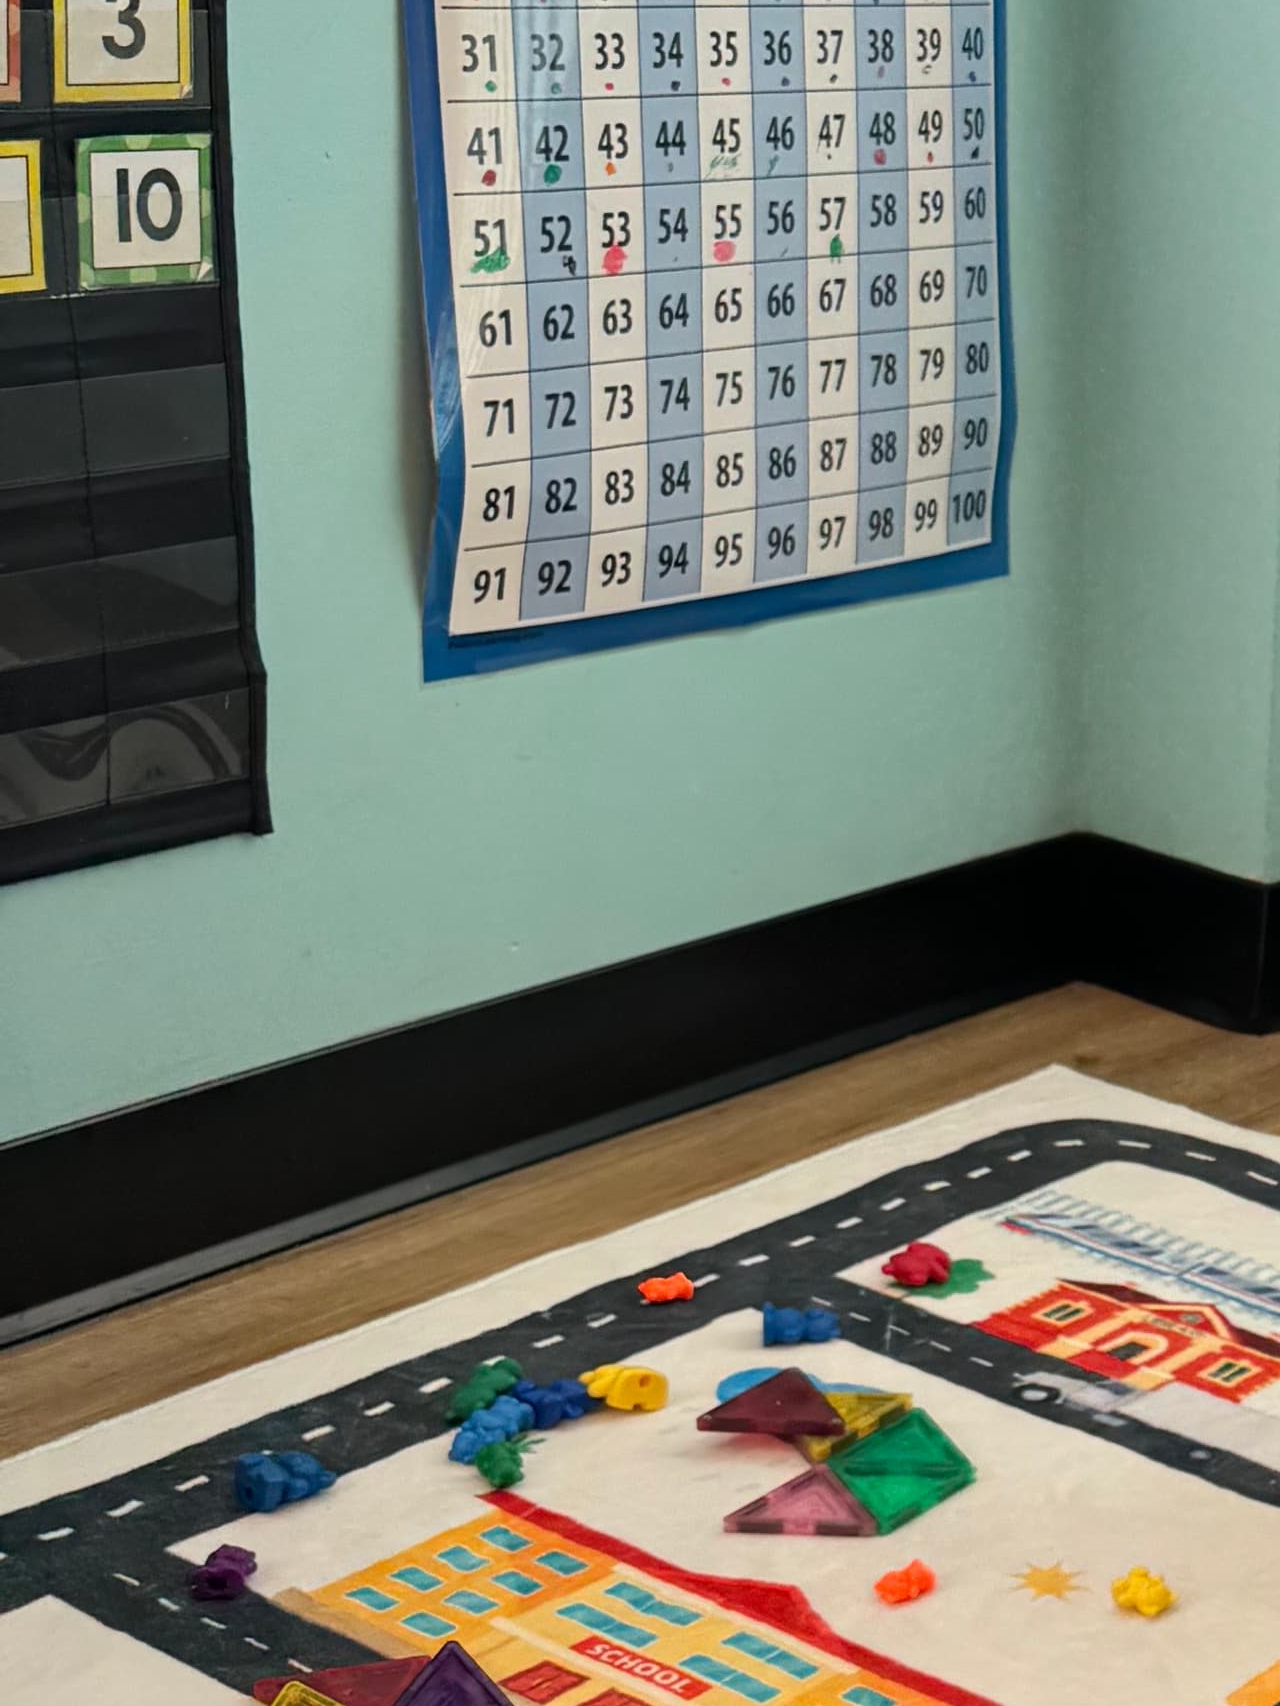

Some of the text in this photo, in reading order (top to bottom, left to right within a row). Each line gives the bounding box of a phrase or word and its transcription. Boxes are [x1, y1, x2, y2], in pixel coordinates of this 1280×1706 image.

[461, 26, 984, 73] 31 32 33 34 35 36 37 38 39 40
[466, 107, 985, 166] 41 42 43 44 45 46 47 48 49 50
[116, 167, 183, 243] 10
[474, 186, 986, 257] 51 52 53 54 55 56 57 58 59 60
[479, 264, 988, 348] 61 62 63 64 65 66 67 68 69 70
[483, 341, 990, 438] 71 72 73 74 75 76 77 78 79 80
[482, 417, 988, 522] 81 82 83 84 85 86 87 88 89 90
[473, 489, 987, 604] 91 92 93 94 95 96 97 98 99 100
[585, 1643, 691, 1694] SCHOOL
